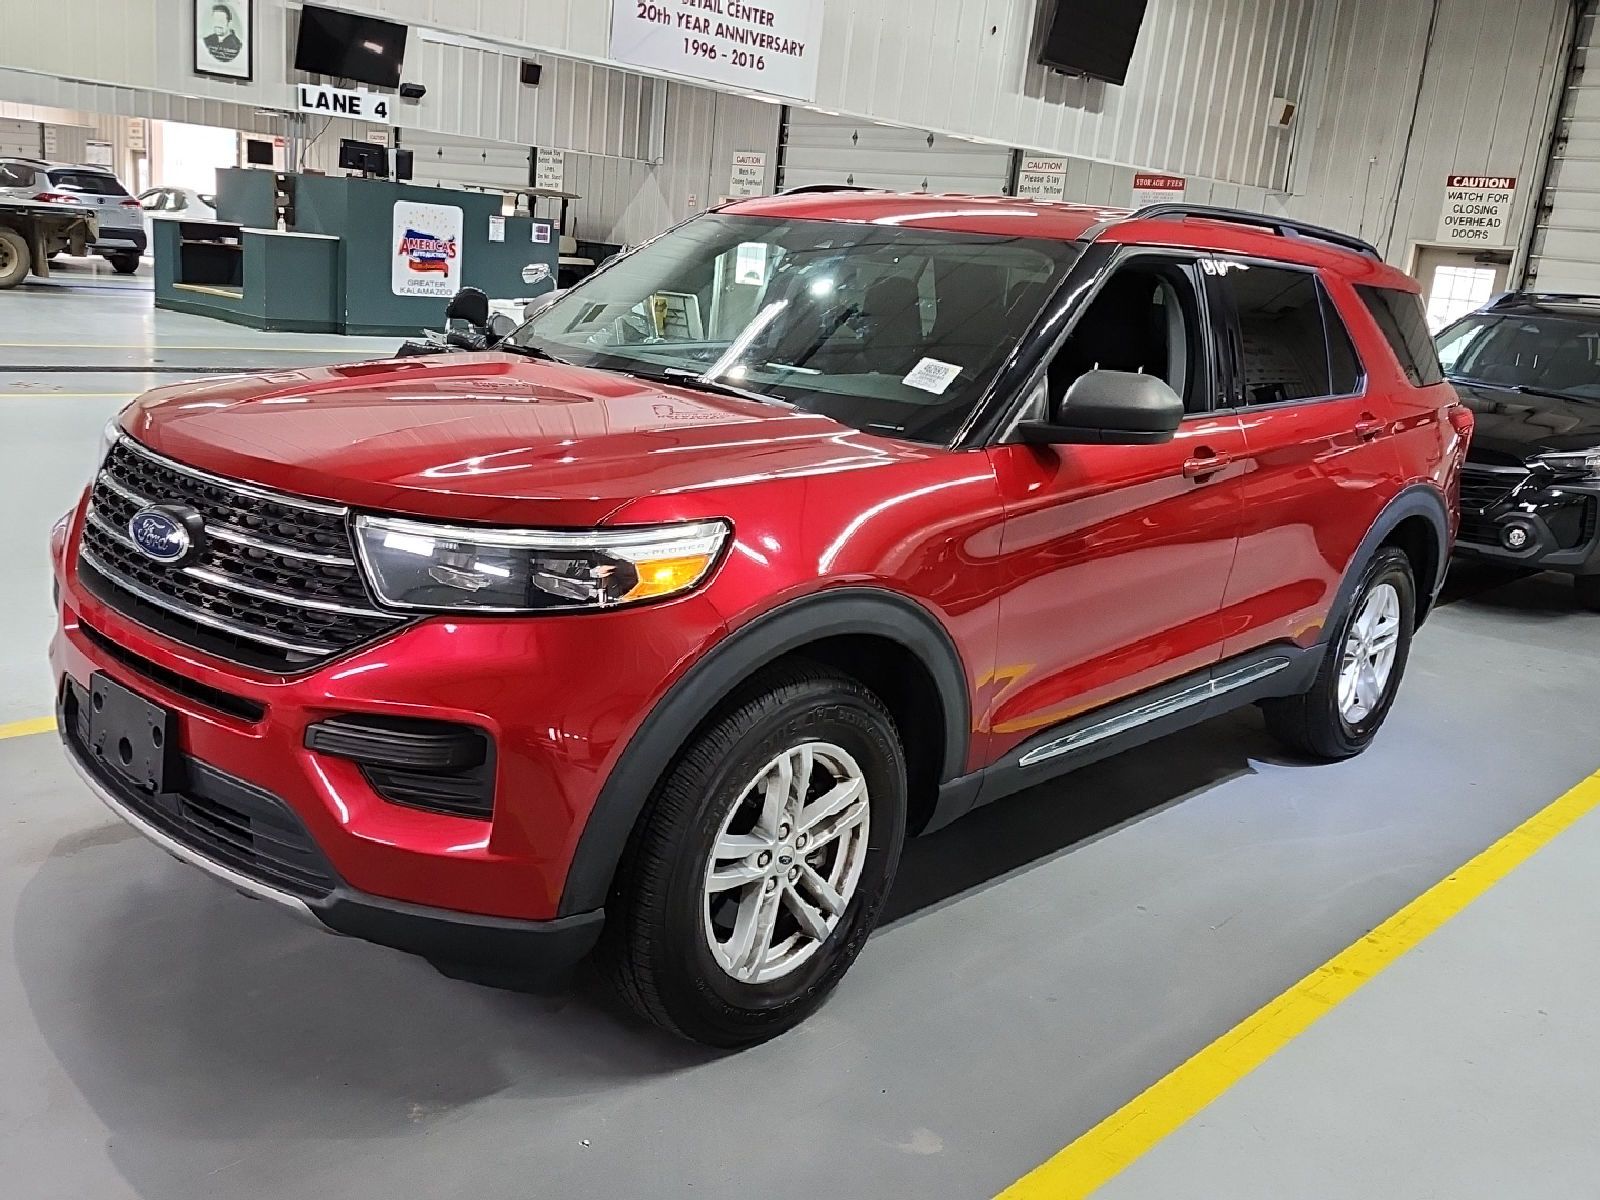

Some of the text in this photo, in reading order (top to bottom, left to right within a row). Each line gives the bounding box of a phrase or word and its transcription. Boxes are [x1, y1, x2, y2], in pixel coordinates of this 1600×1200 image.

[727, 2, 775, 27] CENTER
[637, 3, 805, 57] 20th YEAR ANNIVERSARY
[684, 38, 717, 60] 1996
[731, 50, 765, 70] 2016
[301, 88, 388, 118] LANE 4
[736, 156, 761, 164] CAUTION
[1027, 161, 1062, 170] CAUTION
[1024, 174, 1060, 185] Please Stay
[1136, 178, 1183, 187] STORAGE FEES
[1453, 177, 1510, 188] CAUTION
[1019, 185, 1062, 194] Behind Yellow
[1448, 191, 1509, 203] WATCH FOR
[1453, 204, 1498, 215] CLOSING
[1444, 216, 1501, 227] OVERHEAD
[1451, 228, 1489, 239] DOORS
[407, 279, 446, 288] GREATER
[399, 287, 453, 296] KALAMAZOO
[138, 519, 173, 550] Ford
